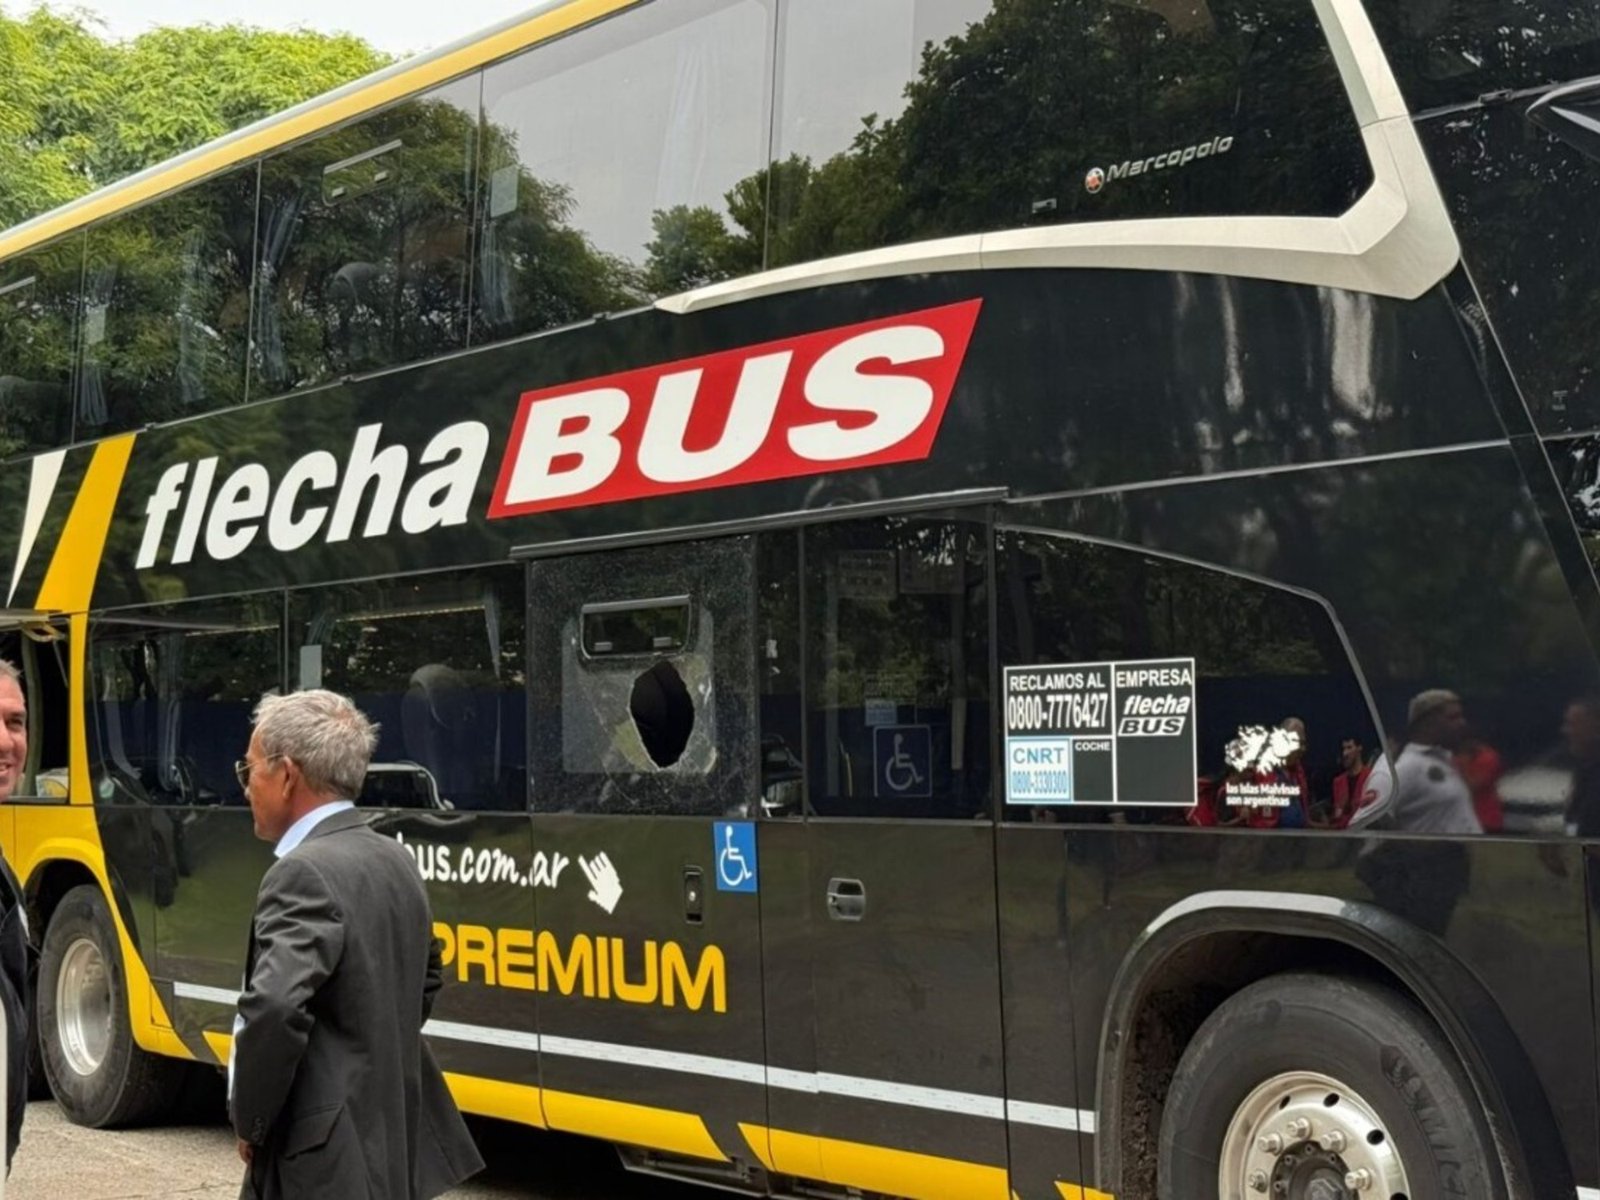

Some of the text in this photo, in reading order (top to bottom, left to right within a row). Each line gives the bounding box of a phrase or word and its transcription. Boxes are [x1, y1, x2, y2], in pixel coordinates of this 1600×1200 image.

[1106, 136, 1234, 183] Marcopolo
[135, 325, 945, 569] flecha BUS
[1009, 672, 1106, 691] RECLAMOS AL
[1116, 668, 1192, 688] EMPRESA
[1008, 693, 1108, 730] 0800-7776427
[1123, 694, 1191, 715] flecha
[1119, 718, 1182, 735] BUS
[1012, 747, 1065, 764] CNRT
[1074, 741, 1111, 751] COCHE
